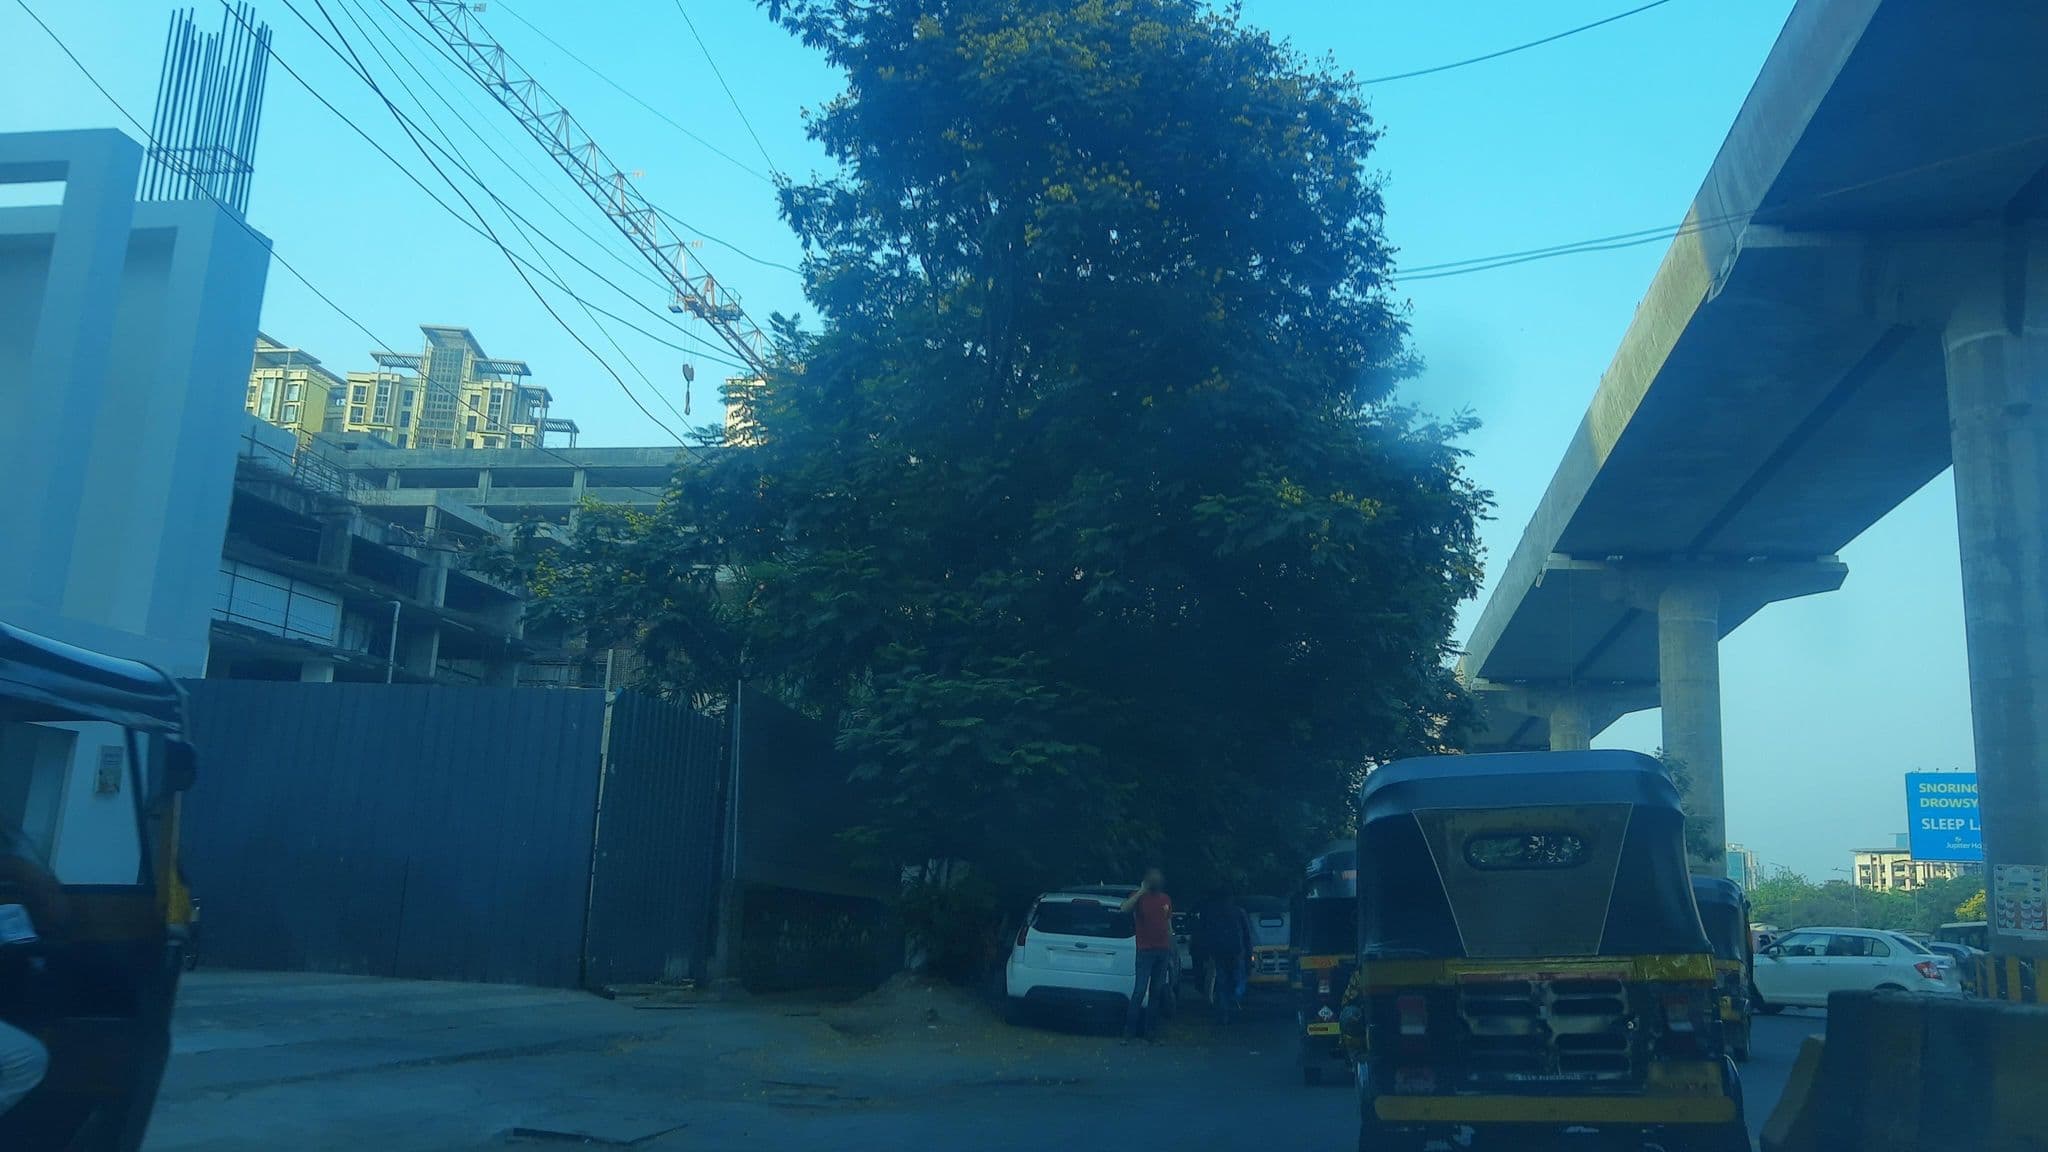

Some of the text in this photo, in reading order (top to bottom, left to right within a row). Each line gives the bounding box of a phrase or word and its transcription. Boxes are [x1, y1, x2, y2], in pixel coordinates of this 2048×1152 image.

[1920, 798, 1979, 808] DROWSY
[1921, 818, 1981, 831] SLEEP L
[1945, 841, 1970, 850] Jupiter
